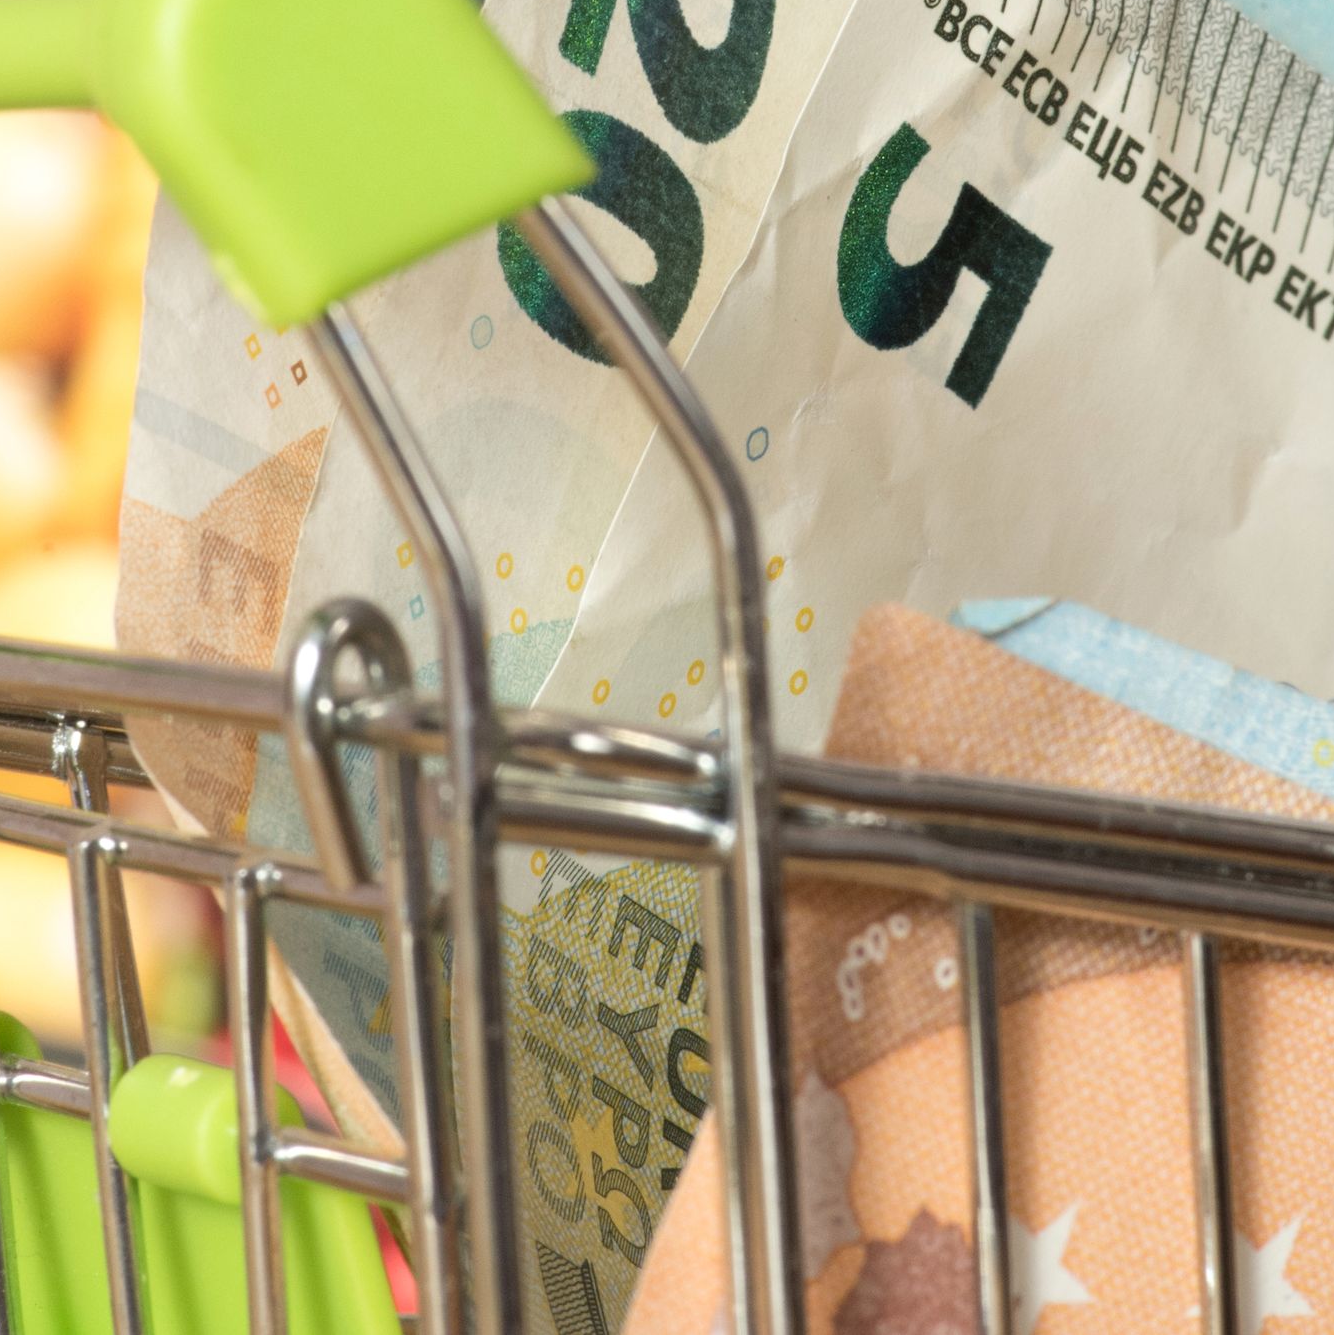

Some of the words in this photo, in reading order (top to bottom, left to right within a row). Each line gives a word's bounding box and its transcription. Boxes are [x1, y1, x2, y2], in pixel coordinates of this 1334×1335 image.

[837, 120, 1054, 411] 5
[1001, 49, 1069, 127] ECB
[1141, 159, 1205, 236] EZB
[1204, 210, 1276, 285] EKP
